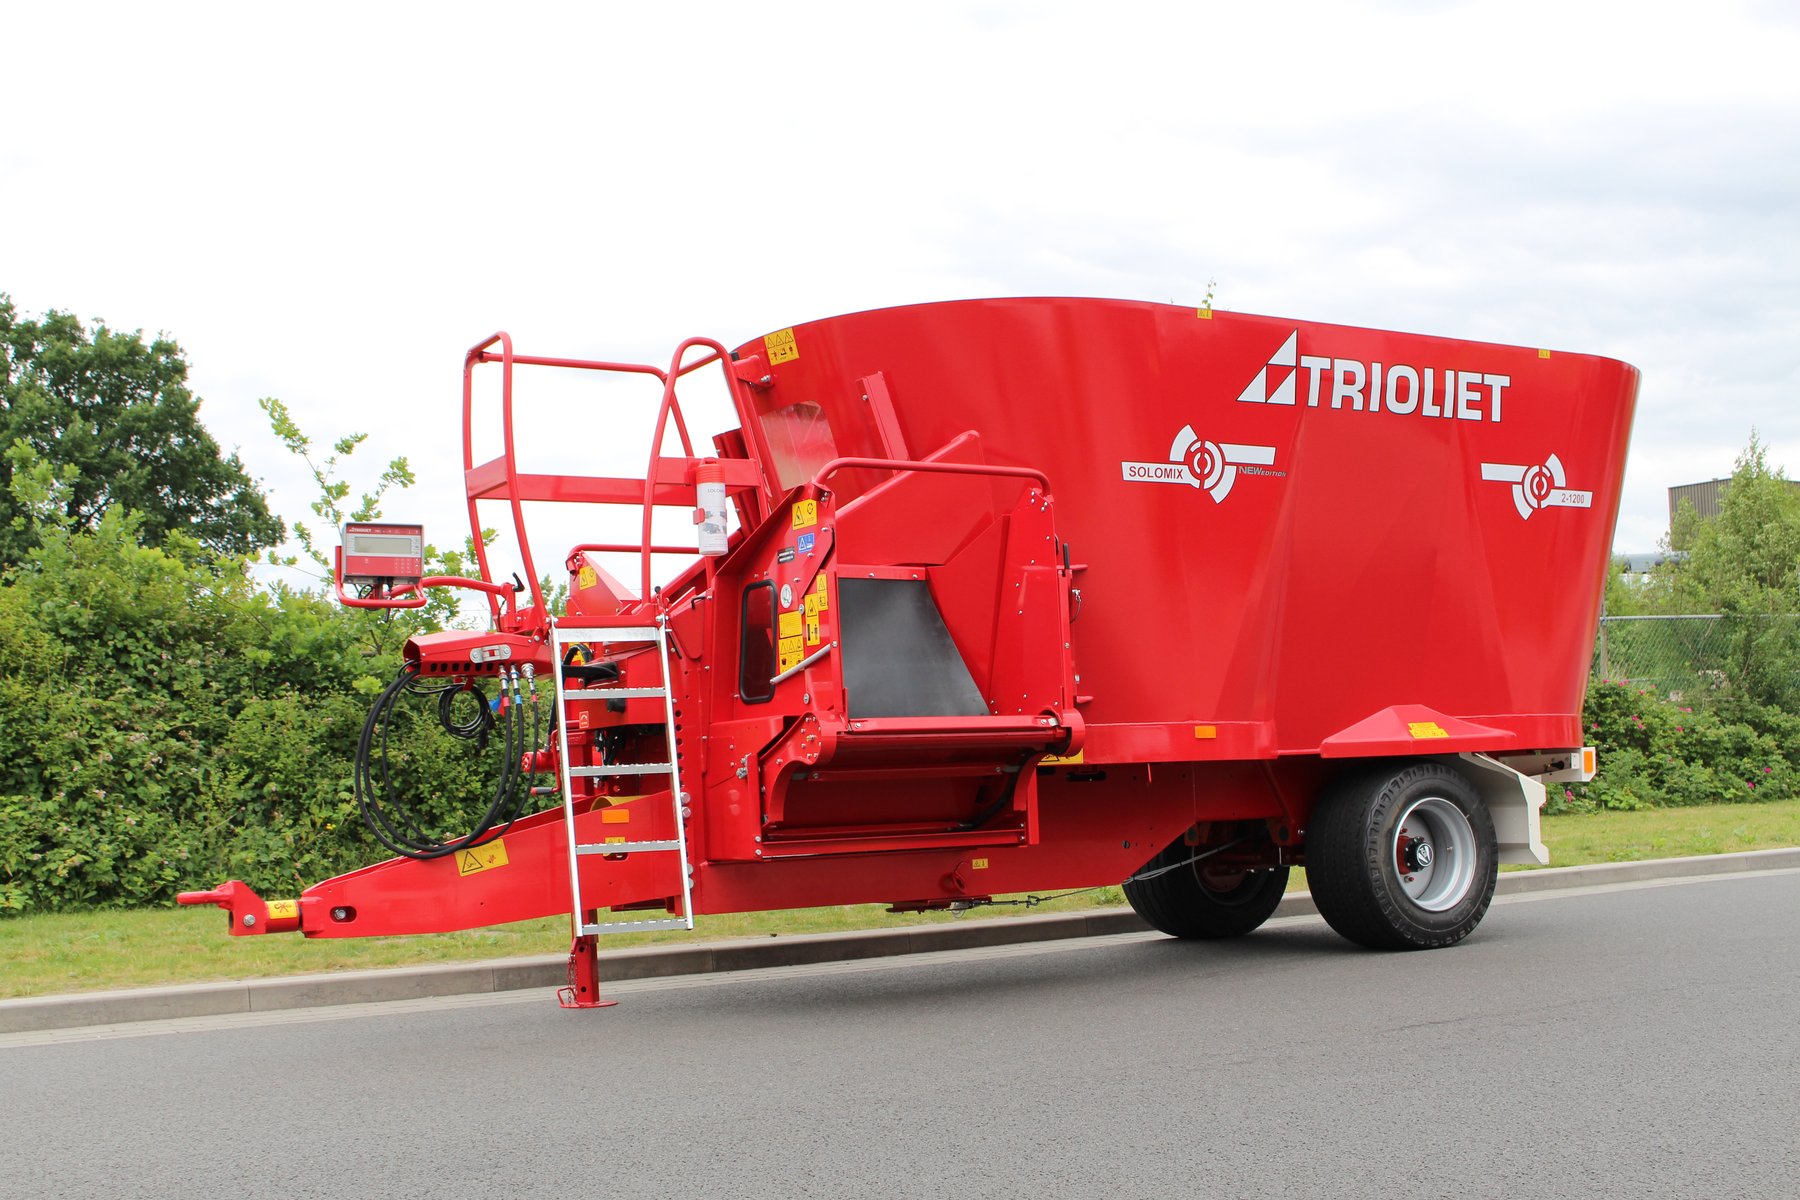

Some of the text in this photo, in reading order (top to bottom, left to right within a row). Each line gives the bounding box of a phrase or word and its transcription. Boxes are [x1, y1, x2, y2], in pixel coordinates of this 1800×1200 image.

[1300, 355, 1511, 422] TRIOLIET
[1129, 466, 1183, 480] SOLOMIX
[1561, 493, 1585, 504] 2-1200
